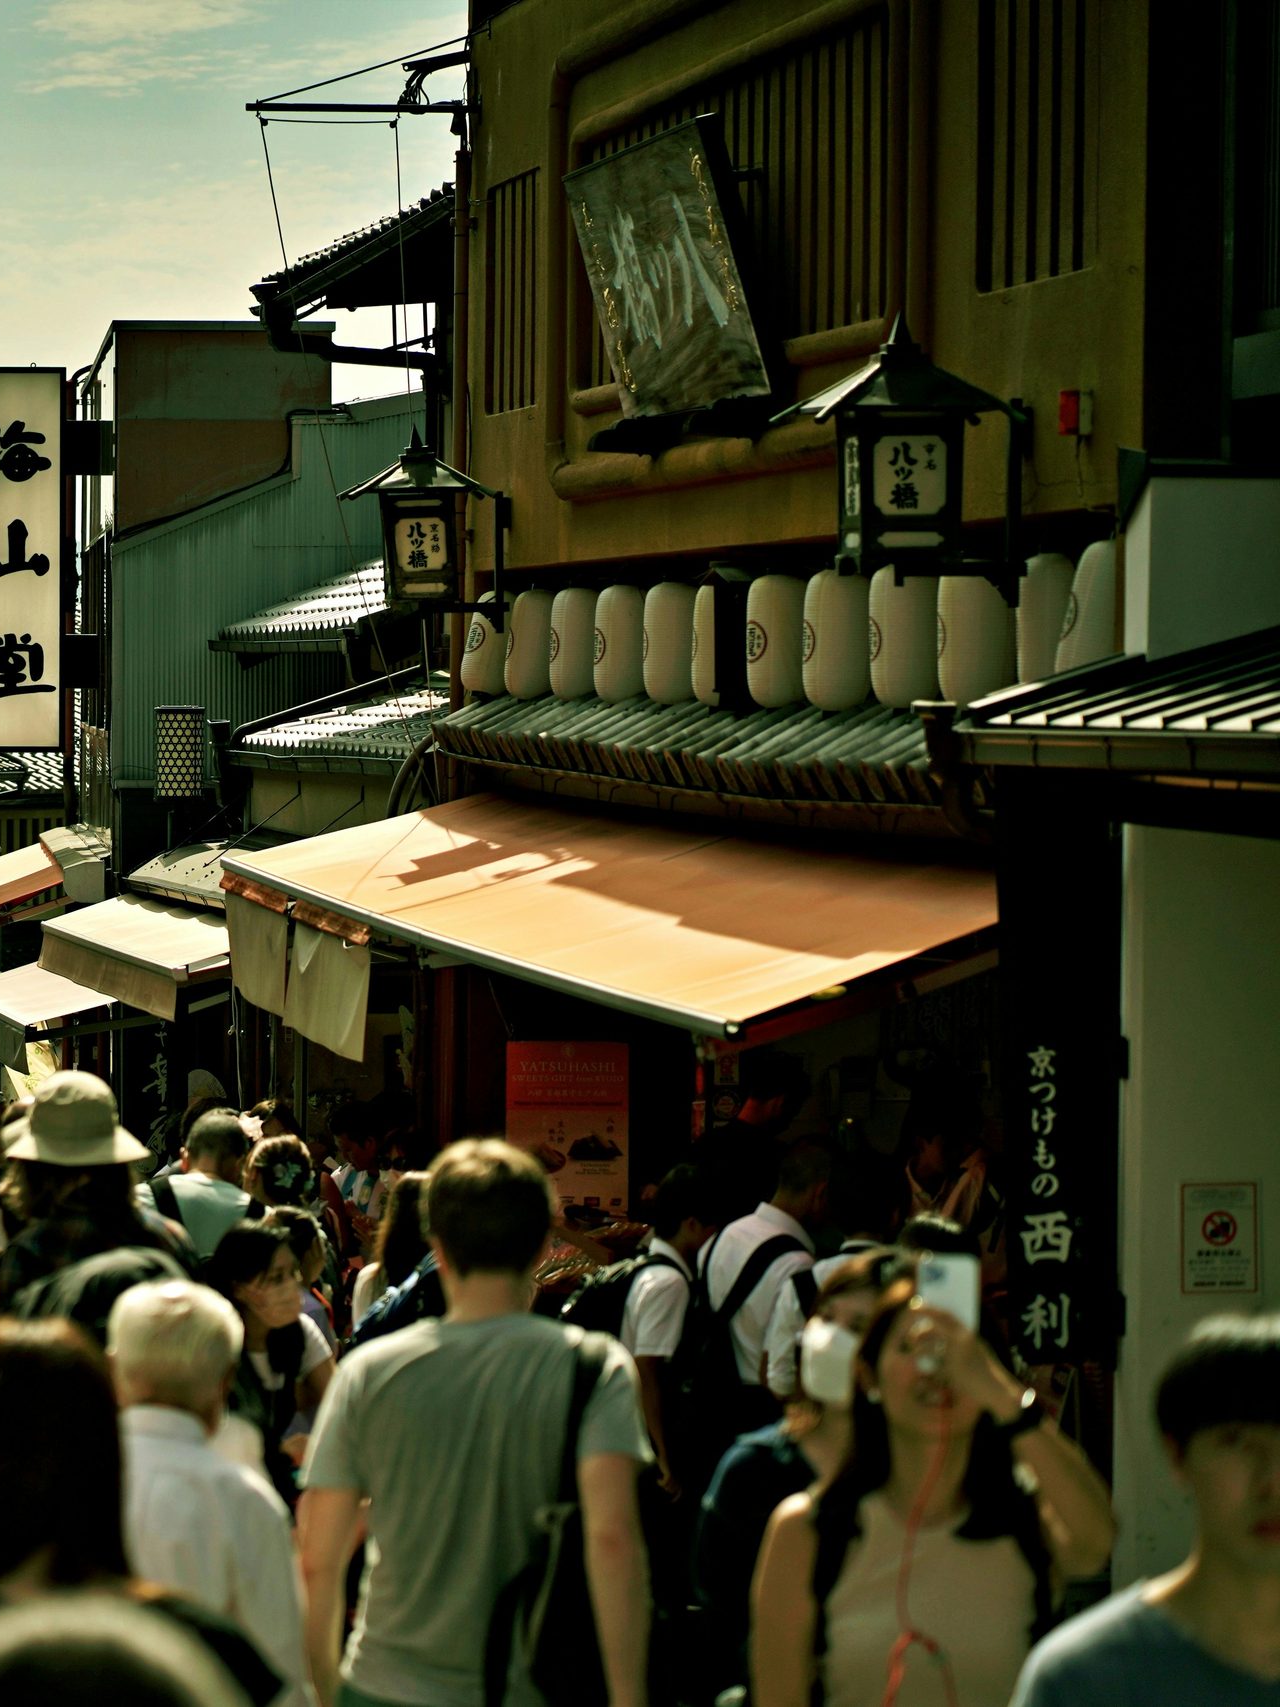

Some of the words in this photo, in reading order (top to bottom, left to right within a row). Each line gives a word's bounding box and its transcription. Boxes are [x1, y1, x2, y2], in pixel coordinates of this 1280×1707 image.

[520, 1060, 616, 1073] YATSUHASHI
[1026, 1044, 1059, 1199] 京つけもの
[1019, 1209, 1074, 1351] 西利
